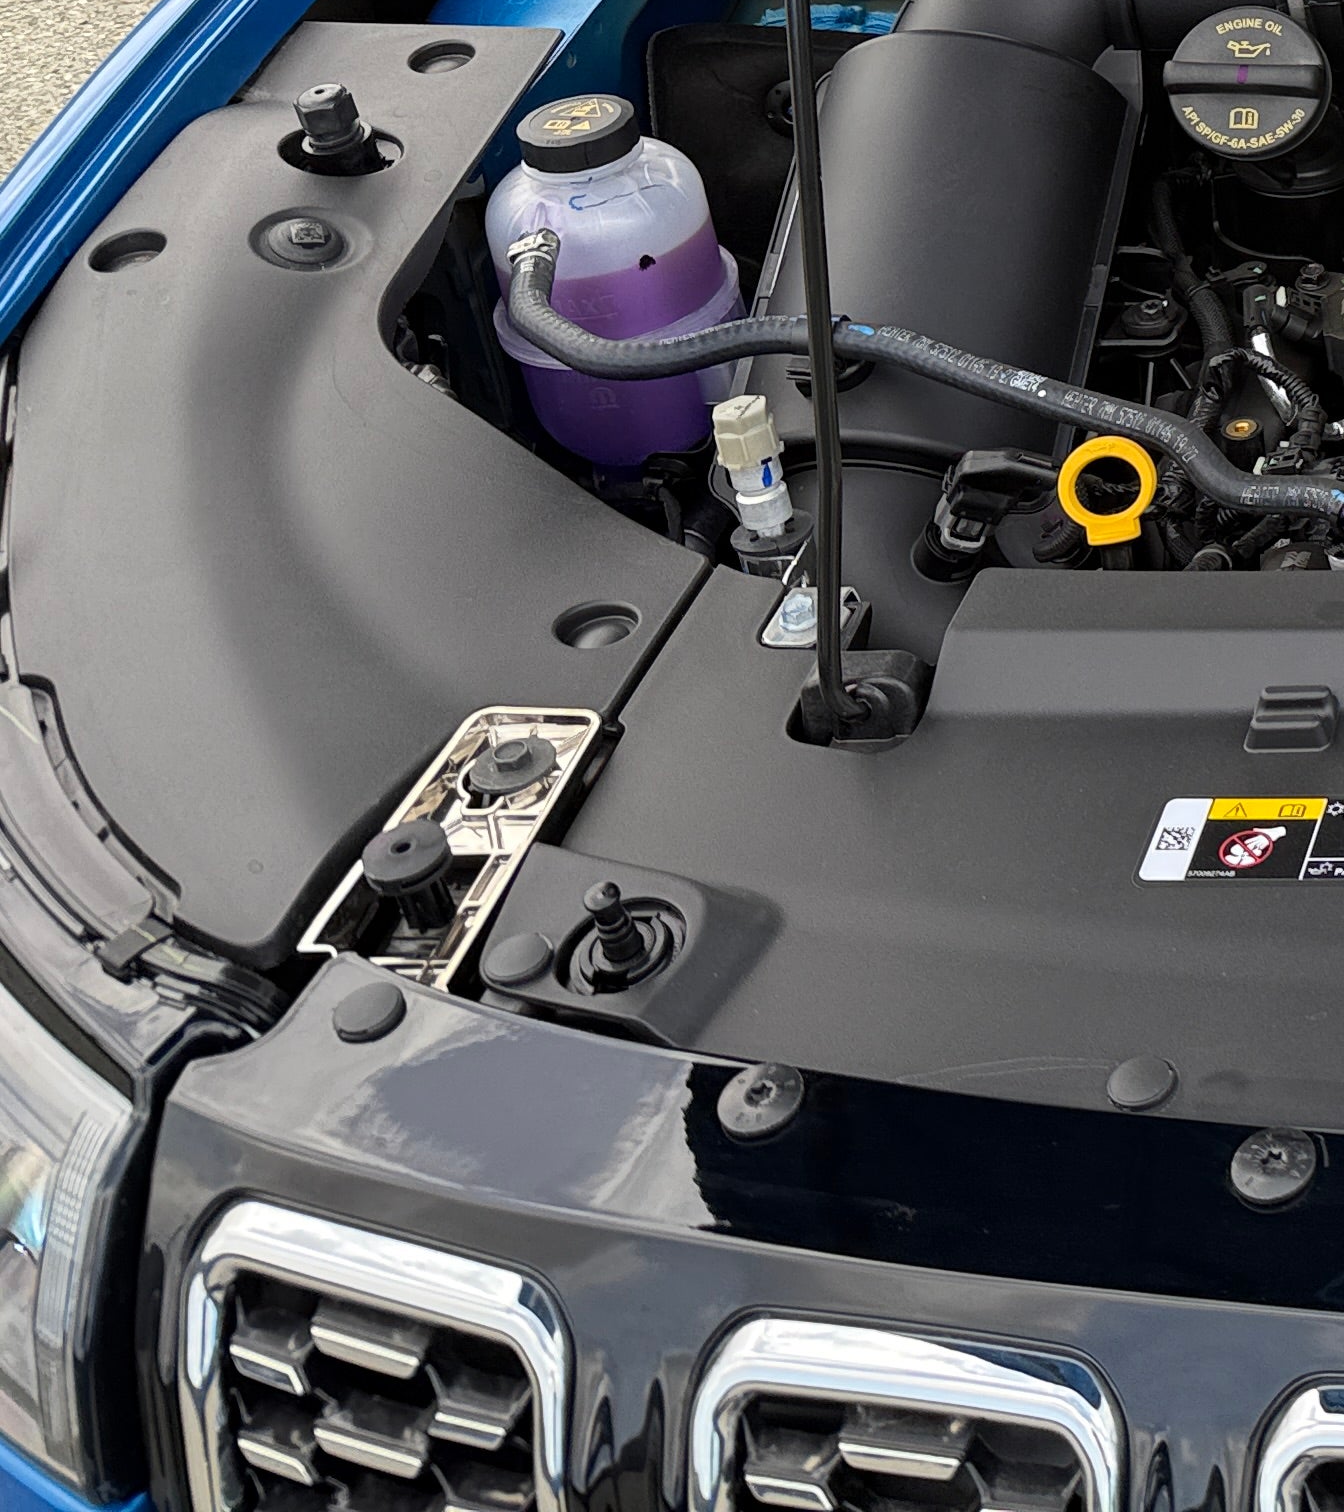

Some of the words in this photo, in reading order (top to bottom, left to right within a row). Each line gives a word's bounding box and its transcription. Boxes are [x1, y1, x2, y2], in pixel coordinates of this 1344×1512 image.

[1215, 18, 1264, 36] ENGINE
[1264, 21, 1285, 37] OIL
[1181, 106, 1202, 126] API
